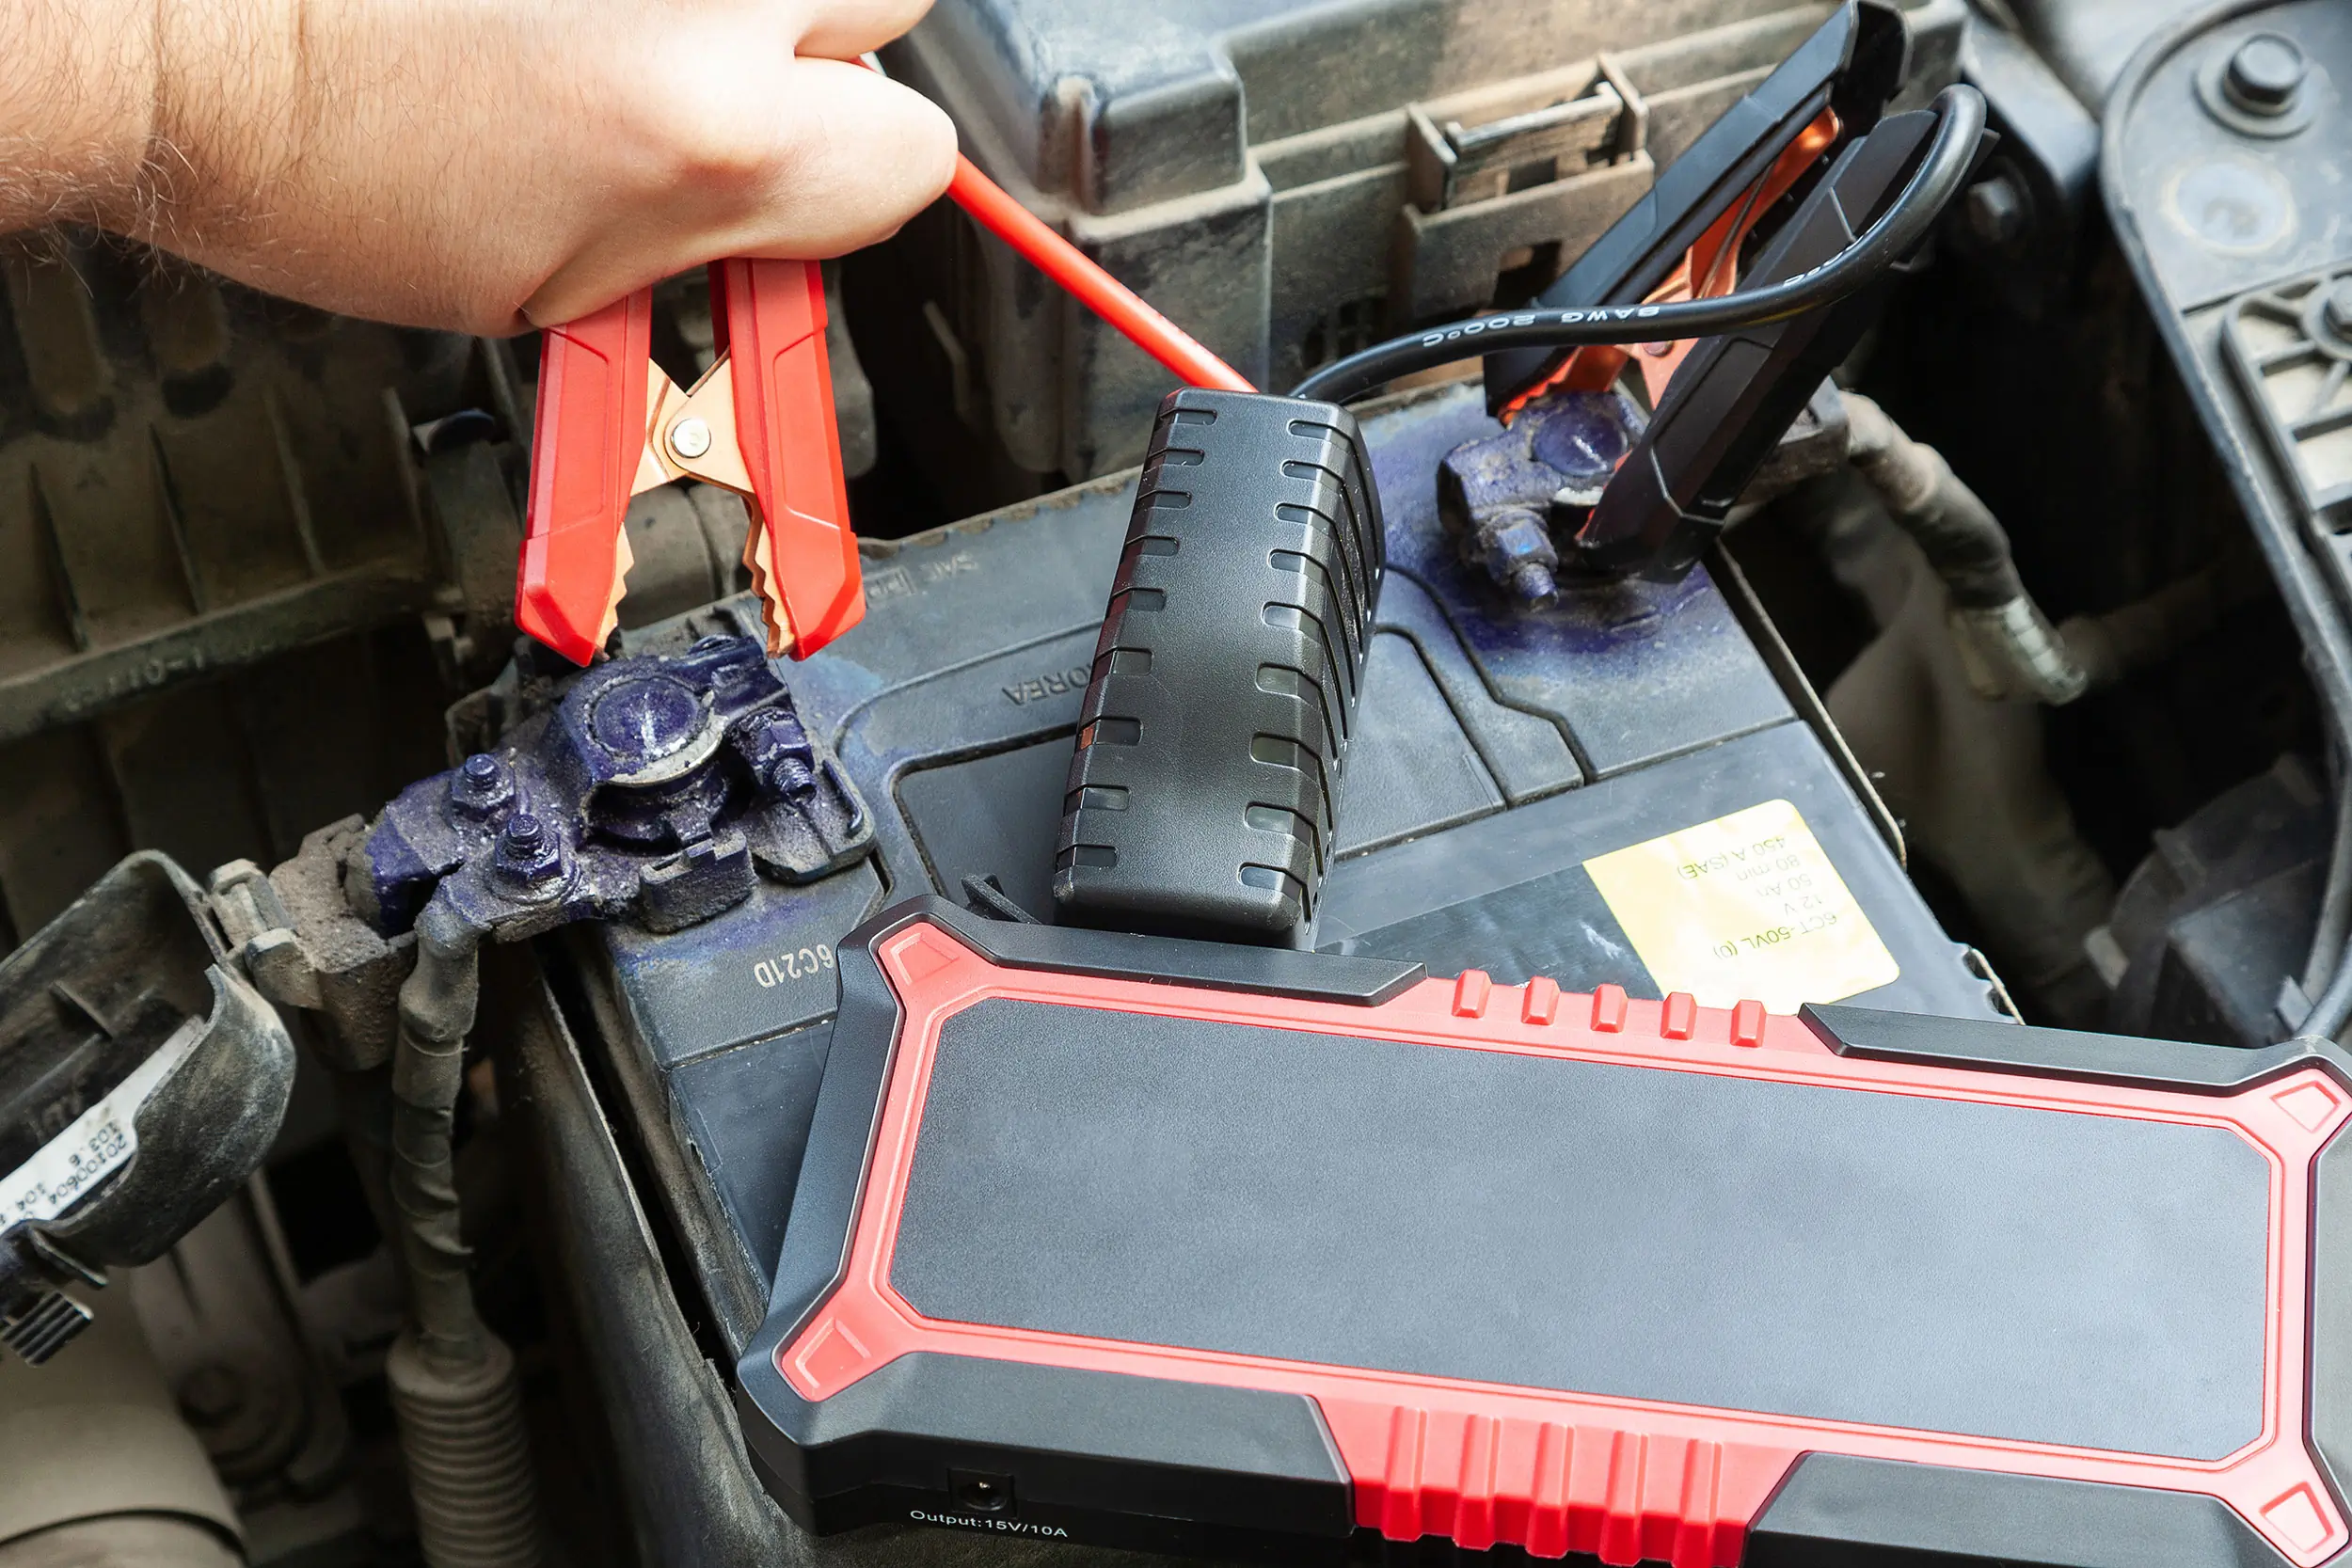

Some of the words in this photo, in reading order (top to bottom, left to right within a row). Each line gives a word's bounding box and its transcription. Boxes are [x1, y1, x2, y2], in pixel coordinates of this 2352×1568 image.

[1731, 848, 1746, 863] A
[1774, 854, 1801, 870] 80
[1677, 851, 1729, 880] (SAE)
[1736, 863, 1771, 881] min
[1788, 872, 1812, 892] 50
[1784, 901, 1796, 915] V
[1802, 894, 1823, 911] 12
[1740, 911, 1837, 950] 6CT-50VL
[754, 943, 835, 989] 6C21D
[48, 1132, 128, 1206] 20100604
